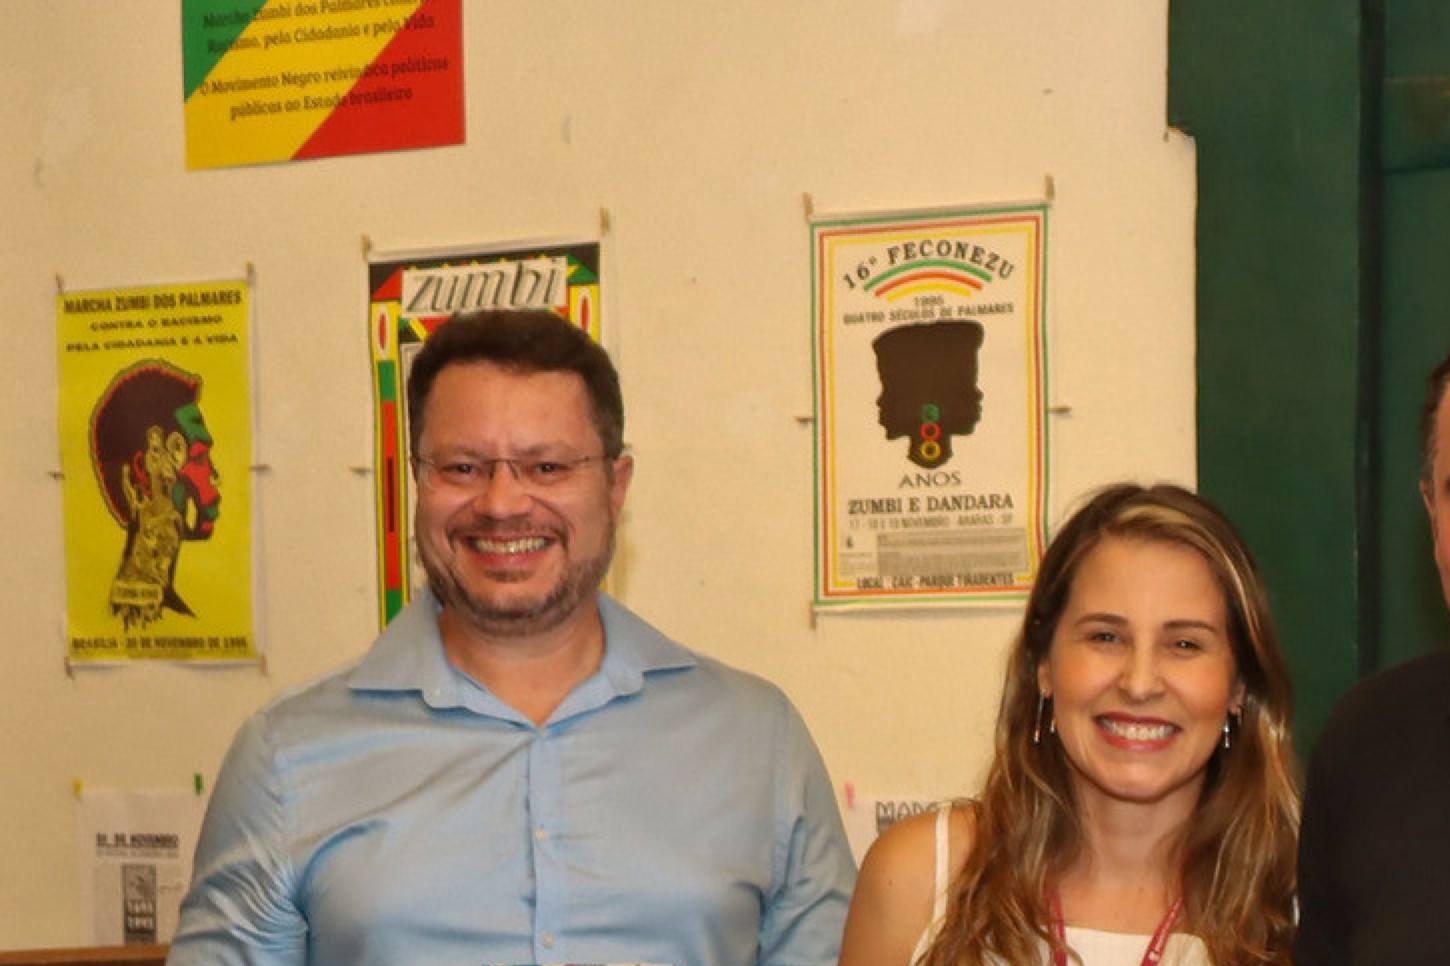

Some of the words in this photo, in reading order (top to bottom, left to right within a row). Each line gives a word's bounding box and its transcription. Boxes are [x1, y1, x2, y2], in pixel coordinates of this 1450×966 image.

[295, 1, 317, 16] dos
[264, 30, 291, 48] pela
[294, 23, 360, 42] Cidadania
[373, 17, 402, 36] pela
[211, 74, 279, 93] Movimento
[281, 68, 321, 88] Negro
[284, 98, 301, 112] ao
[303, 91, 347, 111] Estado
[887, 238, 1015, 279] FECONEZU
[64, 298, 113, 314] MARCHA
[115, 295, 151, 312] ZUMBI
[154, 293, 177, 309] DOS
[179, 290, 242, 306] PALMARES
[957, 302, 1015, 316] PALMARES
[90, 320, 144, 332] CONTRA
[147, 319, 158, 329] O
[161, 314, 223, 328] RACISMO
[65, 342, 100, 353] PELA
[103, 337, 177, 351] CIDADANIA
[193, 335, 203, 345] A
[206, 333, 239, 344] VIDA
[898, 471, 962, 489] ANOS
[847, 498, 903, 516] ZUMBI
[908, 497, 921, 512] E
[926, 493, 1015, 511] DANDARA
[154, 637, 206, 649] NOVEMBRO
